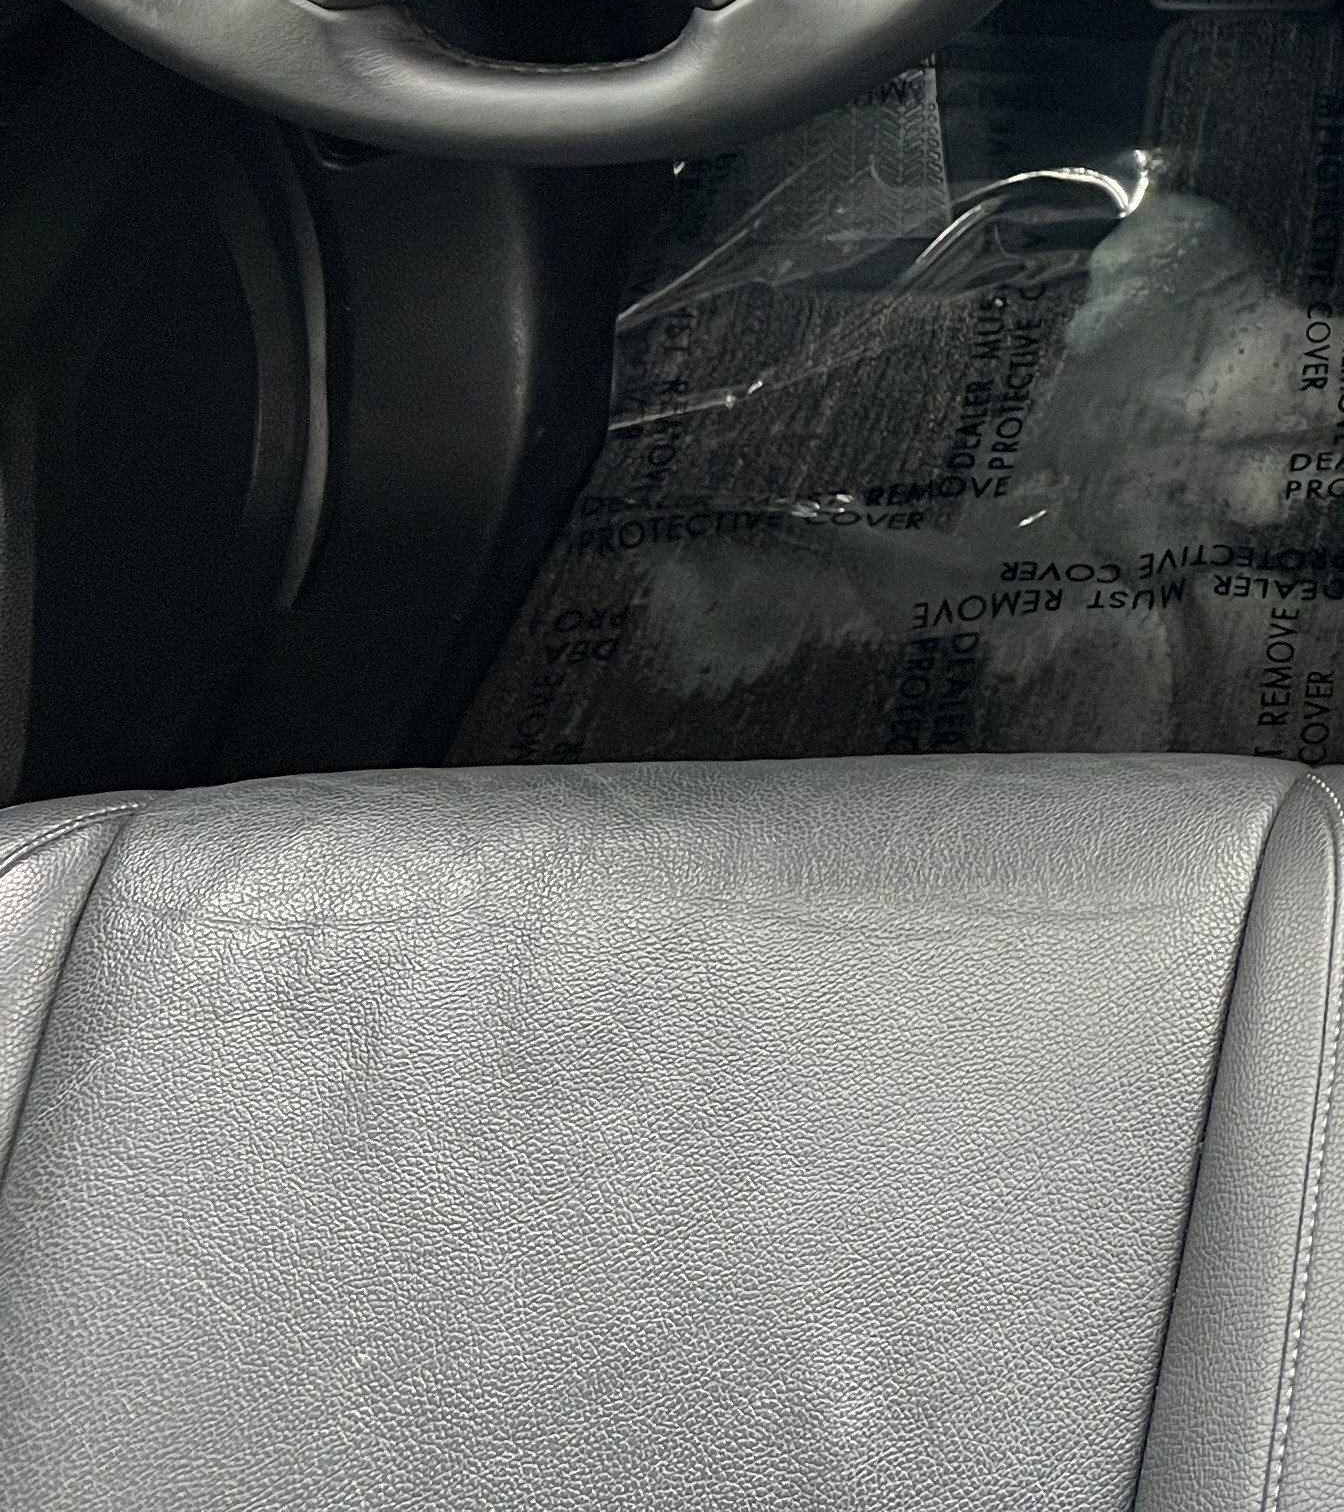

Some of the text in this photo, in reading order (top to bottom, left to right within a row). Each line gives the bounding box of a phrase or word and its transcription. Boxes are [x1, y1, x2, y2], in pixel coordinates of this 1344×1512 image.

[1301, 301, 1334, 392] COVER
[948, 380, 991, 471] DEALER
[988, 314, 1046, 472] PROTECTIVE
[866, 475, 1013, 507] REMOVE
[577, 510, 926, 558] PROTECTIVE COVER
[999, 561, 1122, 584] COVER
[1086, 578, 1187, 610] MUST
[913, 589, 1063, 631] REMOVE
[1258, 606, 1301, 728] REMOVE
[1299, 670, 1336, 766] COVER
